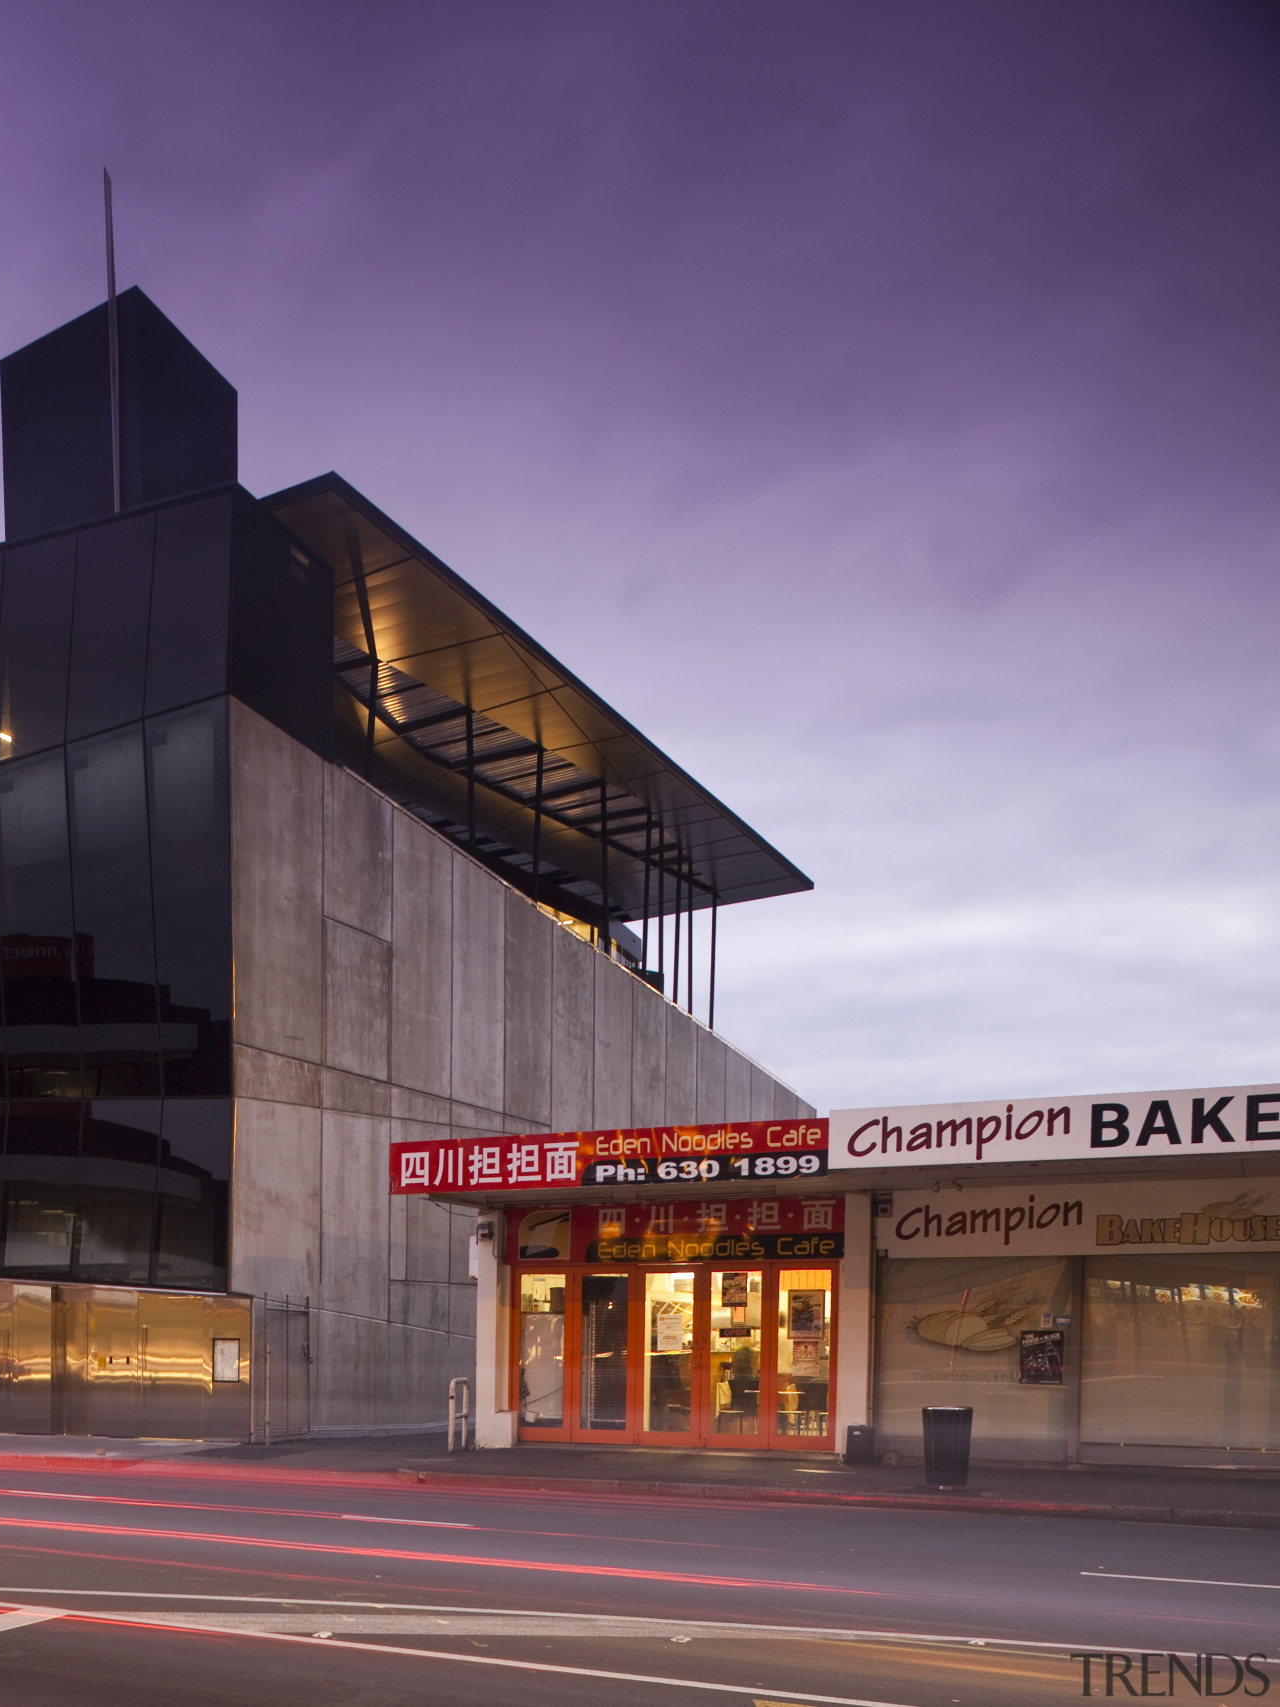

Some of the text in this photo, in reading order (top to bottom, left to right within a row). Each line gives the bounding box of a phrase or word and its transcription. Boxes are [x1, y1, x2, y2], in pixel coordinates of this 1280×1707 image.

[596, 1125, 822, 1156] Eden Noodles Cafe
[847, 1092, 1280, 1160] Champion BAKE
[401, 1141, 579, 1187] 四川担担面
[595, 1155, 821, 1183] Ph: 630 1899
[895, 1194, 1083, 1246] Champion
[597, 1236, 836, 1259] Eden Noodles Cafe
[723, 1329, 747, 1337] OPEN
